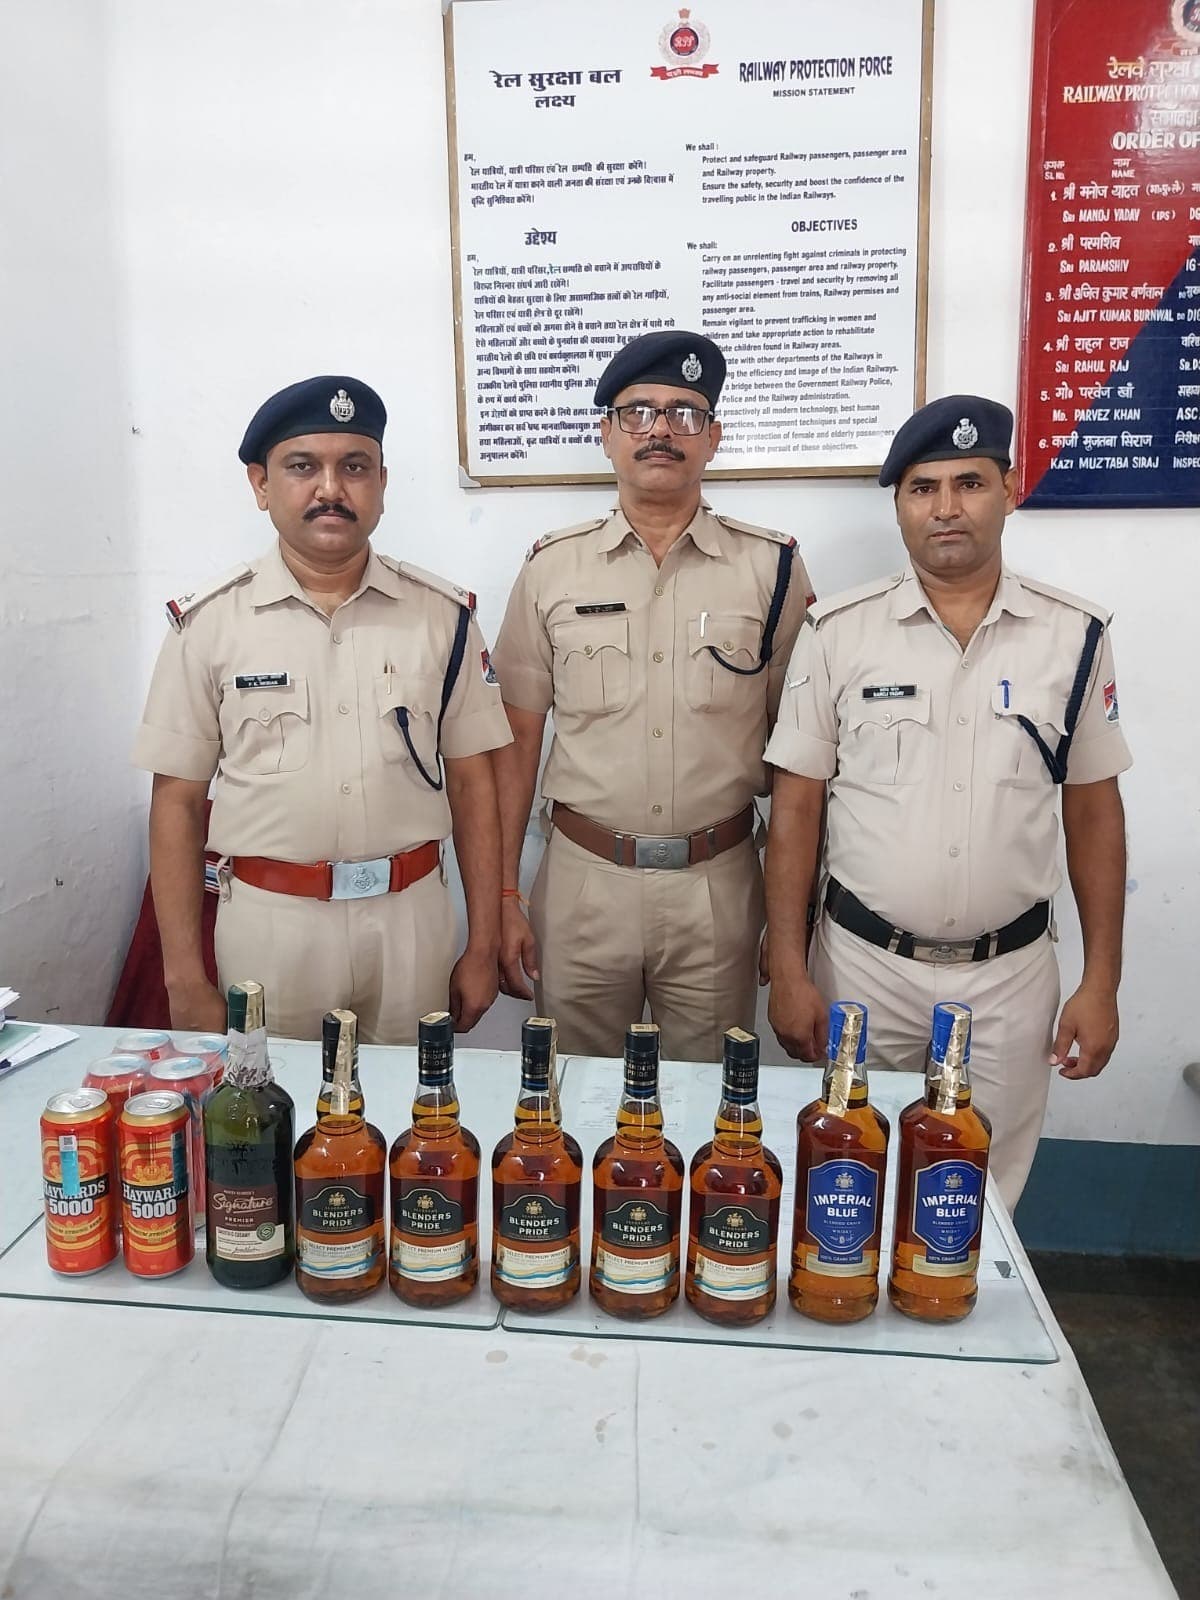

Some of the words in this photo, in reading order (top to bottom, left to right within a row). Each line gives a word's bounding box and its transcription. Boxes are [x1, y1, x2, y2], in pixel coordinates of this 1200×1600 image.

[739, 60, 787, 83] RAILWAY
[789, 57, 856, 81] PROTECTION
[859, 55, 893, 78] FORCE
[1106, 56, 1144, 79] रेलवे
[489, 69, 523, 88] रेल
[528, 71, 584, 92] सुरक्षा
[588, 69, 624, 84] बल
[772, 89, 806, 98] MISSION
[808, 86, 856, 97] STATEMENT
[1063, 84, 1123, 103] RAILWAY
[534, 95, 577, 109] लक्ष्य
[698, 143, 715, 151] shall
[1112, 129, 1176, 151] ORDER
[702, 155, 728, 164] Protect
[729, 155, 742, 163] and
[743, 153, 779, 164] safeguard
[780, 152, 808, 162] Railway
[809, 152, 851, 161] passengers,
[853, 150, 890, 159] passenger
[716, 168, 744, 178] Railway
[745, 168, 776, 177] property.
[1111, 169, 1136, 179] NAME
[702, 182, 726, 191] Ensure
[740, 180, 764, 191] safety,
[765, 179, 794, 189] security
[794, 179, 808, 187] and
[809, 178, 829, 186] boost
[844, 175, 883, 185] confidence
[884, 175, 892, 183] of
[893, 174, 905, 183] the
[1080, 181, 1109, 200] मनोज
[702, 194, 734, 206] travelling
[735, 194, 757, 203] public
[766, 193, 778, 201] the
[779, 192, 802, 200] Indian
[803, 190, 837, 201] Railways.
[1079, 208, 1110, 222] MANOJ
[1113, 208, 1141, 222] YADAV
[791, 219, 858, 233] OBJECTIVES
[524, 227, 557, 246] उद्देश्य
[687, 242, 697, 250] We
[699, 241, 717, 250] shall:
[702, 254, 721, 264] Carry
[743, 252, 782, 263] unrelenting
[783, 251, 800, 261] fight
[801, 250, 827, 261] against
[828, 248, 861, 258] criminals
[862, 248, 869, 256] in
[870, 247, 907, 258] protecting
[702, 267, 727, 277] railway
[728, 267, 770, 276] passengers,
[771, 265, 807, 275] passenger
[825, 263, 839, 271] and
[840, 261, 866, 272] railway
[1078, 258, 1129, 273] PARAMSHIV
[702, 295, 714, 303] any
[716, 292, 751, 301] anti-social
[753, 291, 781, 299] element
[782, 290, 798, 298] from
[800, 289, 822, 298] trains,
[823, 288, 851, 298] Railway
[852, 288, 885, 296] permises
[886, 286, 900, 294] and
[1102, 285, 1130, 303] कुमार
[1073, 309, 1098, 323] AJIT
[1099, 308, 1132, 322] KUMAR
[1133, 308, 1174, 322] BURNWAL
[1074, 336, 1104, 354] राहुल
[1109, 336, 1130, 351] राज
[1074, 359, 1106, 373] RAHUL
[1109, 359, 1130, 373] RAJ
[731, 382, 753, 392] bridge
[754, 382, 784, 390] between
[784, 381, 796, 389] the
[798, 379, 839, 388] Government
[841, 378, 868, 388] Railway
[869, 377, 893, 386] Police,
[1039, 390, 1051, 402] 5.
[1078, 381, 1115, 400] परवेज
[1074, 408, 1111, 422] PARVEZ
[1113, 407, 1141, 421] KHAN
[1051, 430, 1079, 449] काजी
[1120, 430, 1154, 448] सिराज
[1050, 457, 1074, 470] KAZI
[1078, 456, 1129, 470] MUZTABA
[1131, 456, 1160, 469] SIRAJ
[48, 1198, 94, 1217] 5000
[212, 1192, 274, 1214] Signature
[813, 1194, 872, 1208] IMPERIAL
[921, 1194, 978, 1208] IMPERIAL
[131, 1198, 177, 1219] 5000
[312, 1207, 364, 1219] BLENDERS
[402, 1209, 452, 1221] BLENDERS
[826, 1207, 859, 1218] BLUE
[936, 1207, 967, 1218] BLUE
[322, 1218, 353, 1227] PRIDE
[411, 1220, 441, 1230] PRIDE
[509, 1216, 560, 1227] BLENDERS
[612, 1222, 663, 1233] BLENDERS
[518, 1227, 550, 1236] PRIDE
[622, 1233, 653, 1242] PRIDE
[709, 1226, 760, 1240] BLENDERS
[718, 1238, 750, 1248] PRIDE
